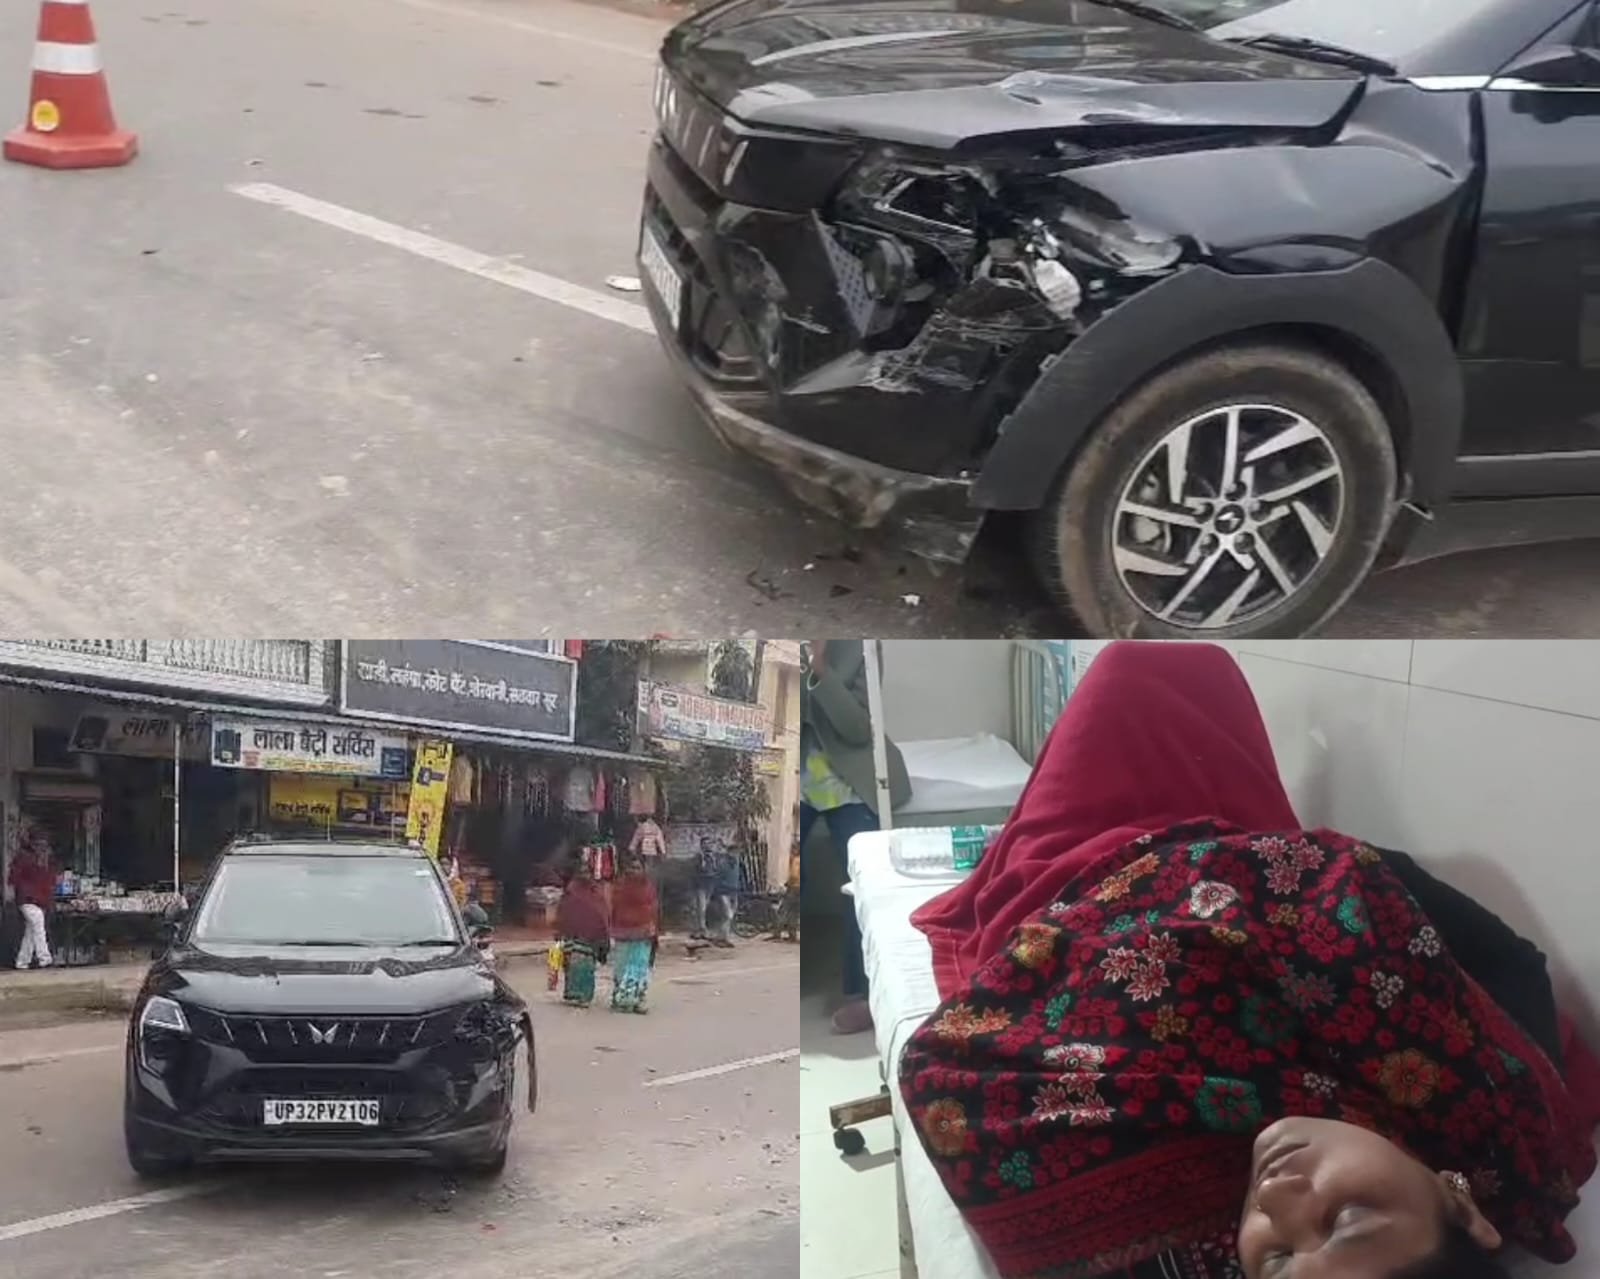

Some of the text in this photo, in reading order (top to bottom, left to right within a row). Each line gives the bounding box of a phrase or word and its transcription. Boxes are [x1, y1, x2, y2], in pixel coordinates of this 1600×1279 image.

[254, 728, 294, 750] लाला
[333, 731, 376, 758] सर्विस
[275, 1103, 379, 1121] UP32PV2106
